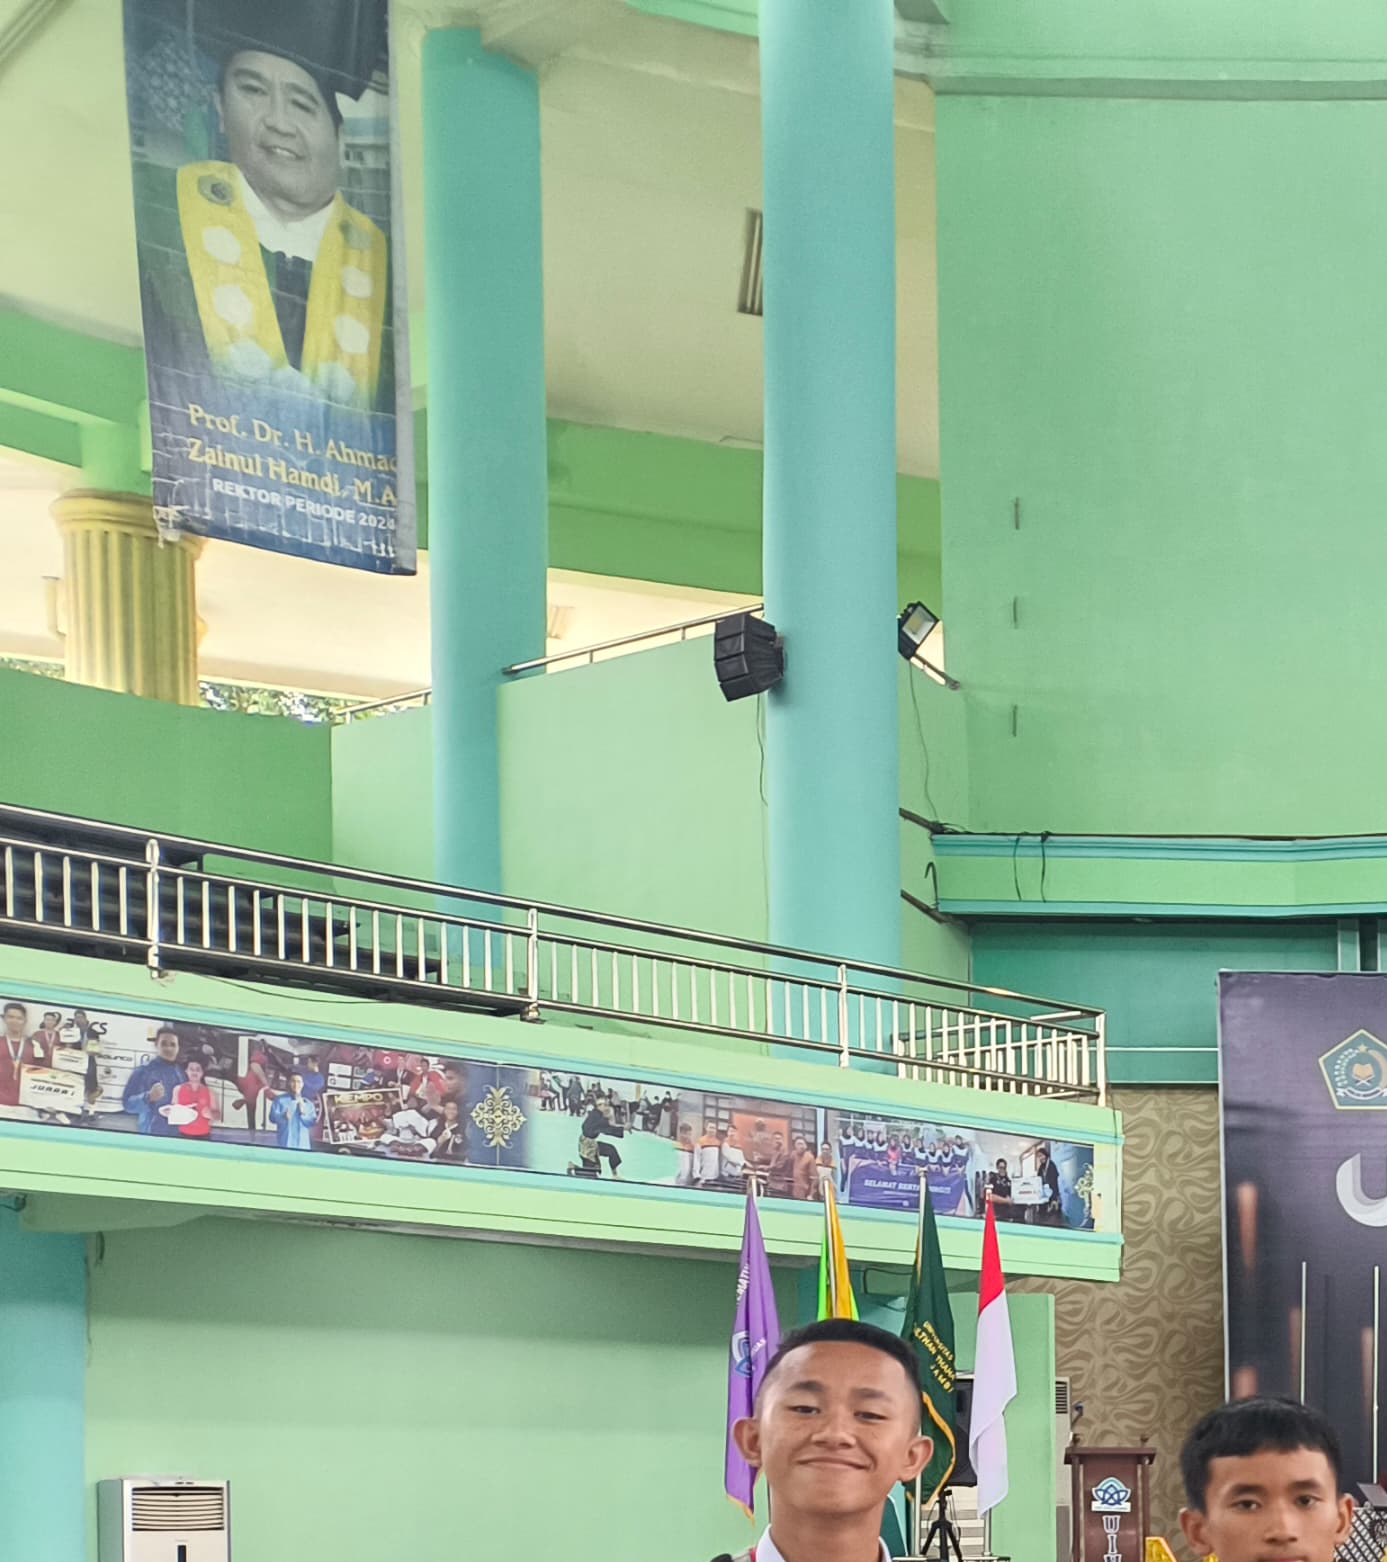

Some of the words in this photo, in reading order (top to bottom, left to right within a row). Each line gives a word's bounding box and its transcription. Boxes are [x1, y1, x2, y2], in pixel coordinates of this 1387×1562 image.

[189, 403, 247, 438] Prof.
[252, 419, 288, 448] Dr.
[295, 429, 320, 455] H.
[187, 438, 262, 477] Zainul
[269, 455, 347, 497] Hamdi,
[212, 479, 281, 505] REKTOR
[286, 494, 355, 522] PERIODE
